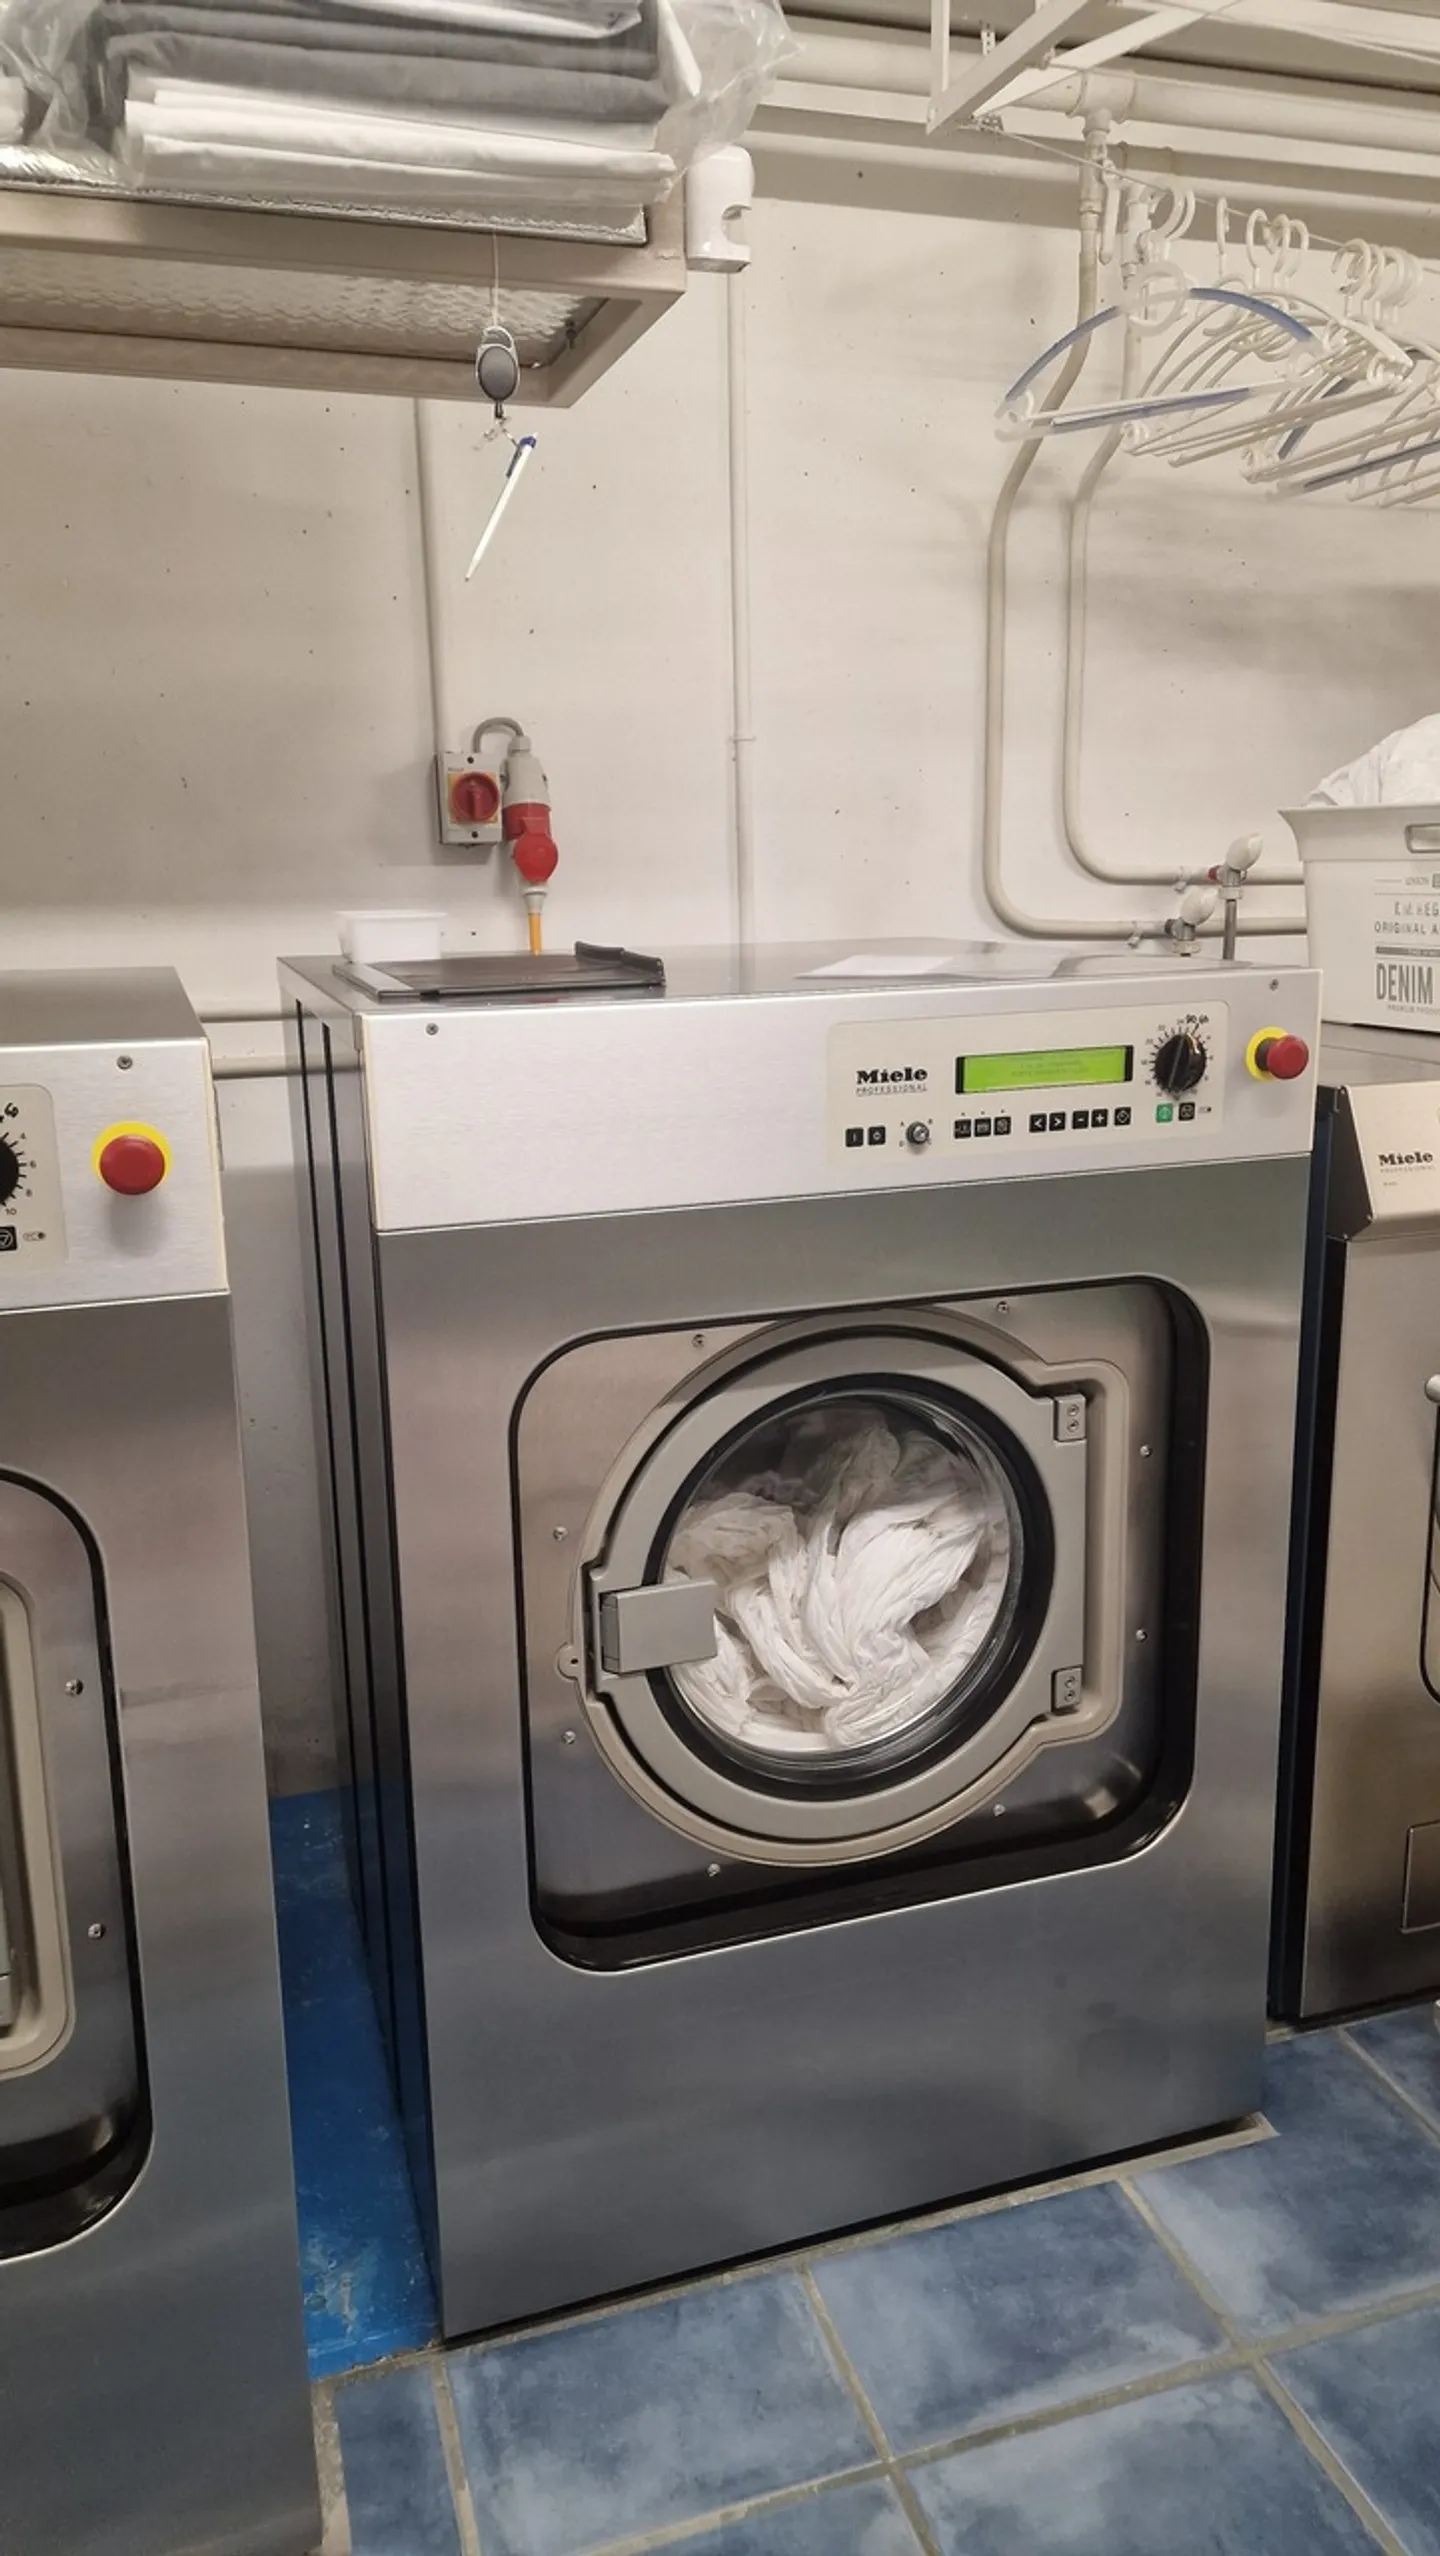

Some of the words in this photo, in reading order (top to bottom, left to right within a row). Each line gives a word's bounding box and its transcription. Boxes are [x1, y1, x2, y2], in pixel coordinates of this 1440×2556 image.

[1374, 920, 1427, 935] ORIGINAL
[1376, 963, 1433, 1005] DENIM
[856, 1066, 928, 1085] Miele
[856, 1083, 928, 1097] PROFESSIONAL
[1378, 1151, 1433, 1167] Miele
